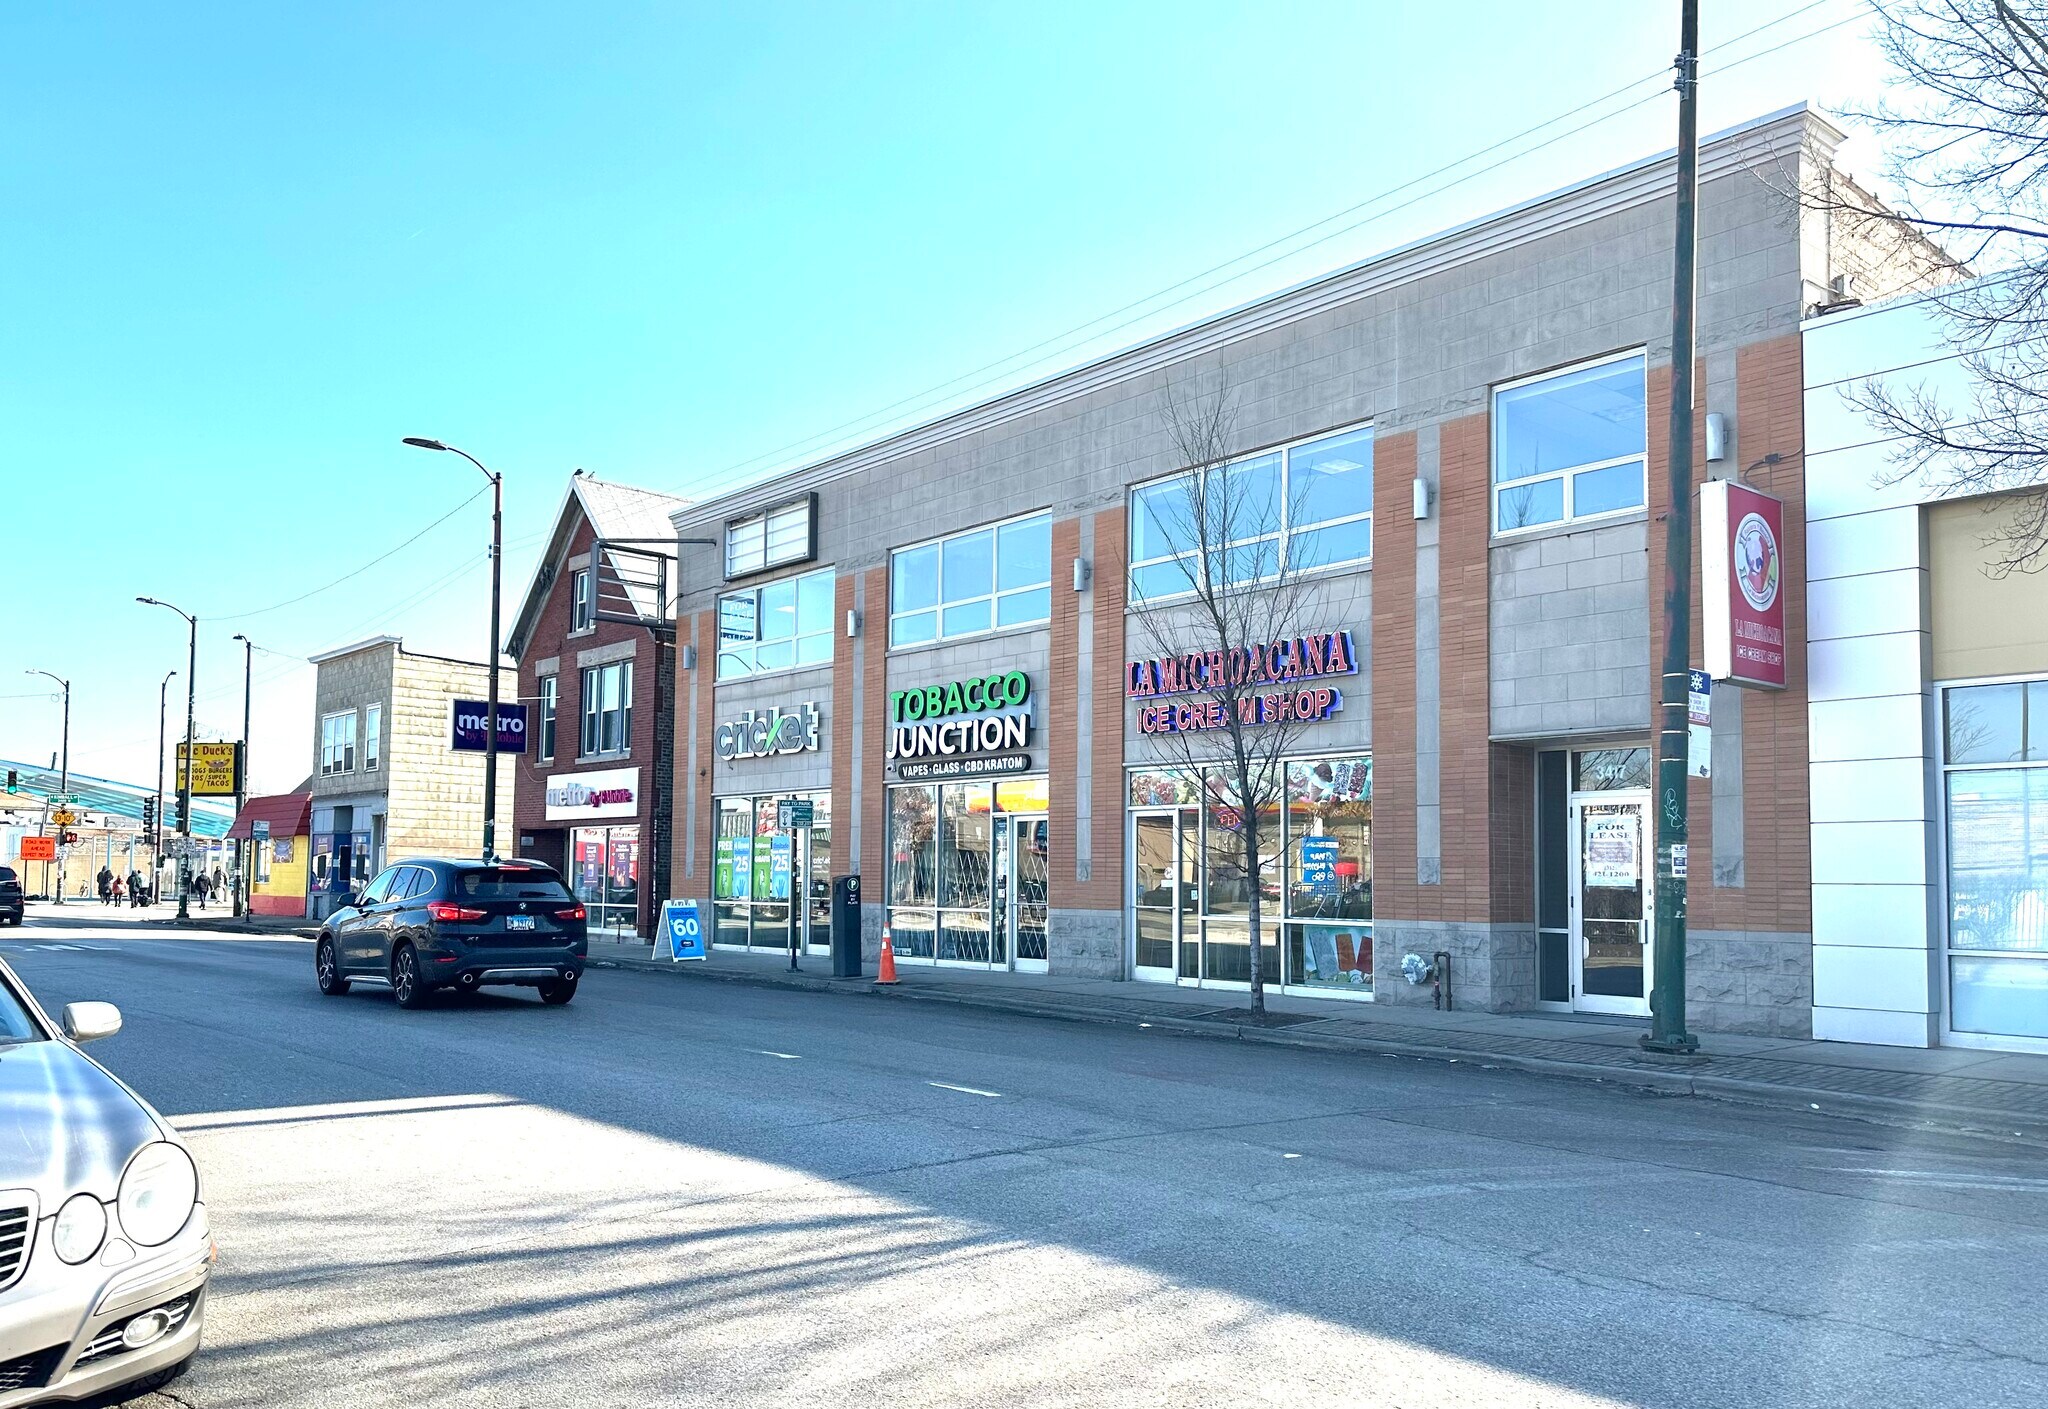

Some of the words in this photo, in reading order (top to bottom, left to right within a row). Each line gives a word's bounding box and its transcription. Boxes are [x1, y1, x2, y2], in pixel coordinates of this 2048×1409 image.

[1126, 660, 1156, 697] LA
[1159, 631, 1350, 693] MICHOACANA
[1736, 644, 1747, 659] ICE
[1767, 650, 1782, 666] SHOP
[889, 670, 1028, 723] TOBACCO
[1136, 705, 1170, 734] ICE
[1262, 687, 1331, 722] SHOP
[456, 713, 524, 736] metro
[715, 702, 818, 760] cricket
[886, 713, 1029, 760] JUNCTION
[202, 745, 233, 756] Duck's
[902, 765, 929, 777] VAPES
[932, 762, 960, 775] GLASS
[964, 759, 983, 772] CBD
[984, 756, 1023, 768] KRATOM
[546, 783, 595, 807] metro
[1218, 812, 1241, 826] PEN
[1597, 823, 1625, 831] FOR
[717, 840, 733, 851] FREE
[1590, 831, 1632, 840] LEASE
